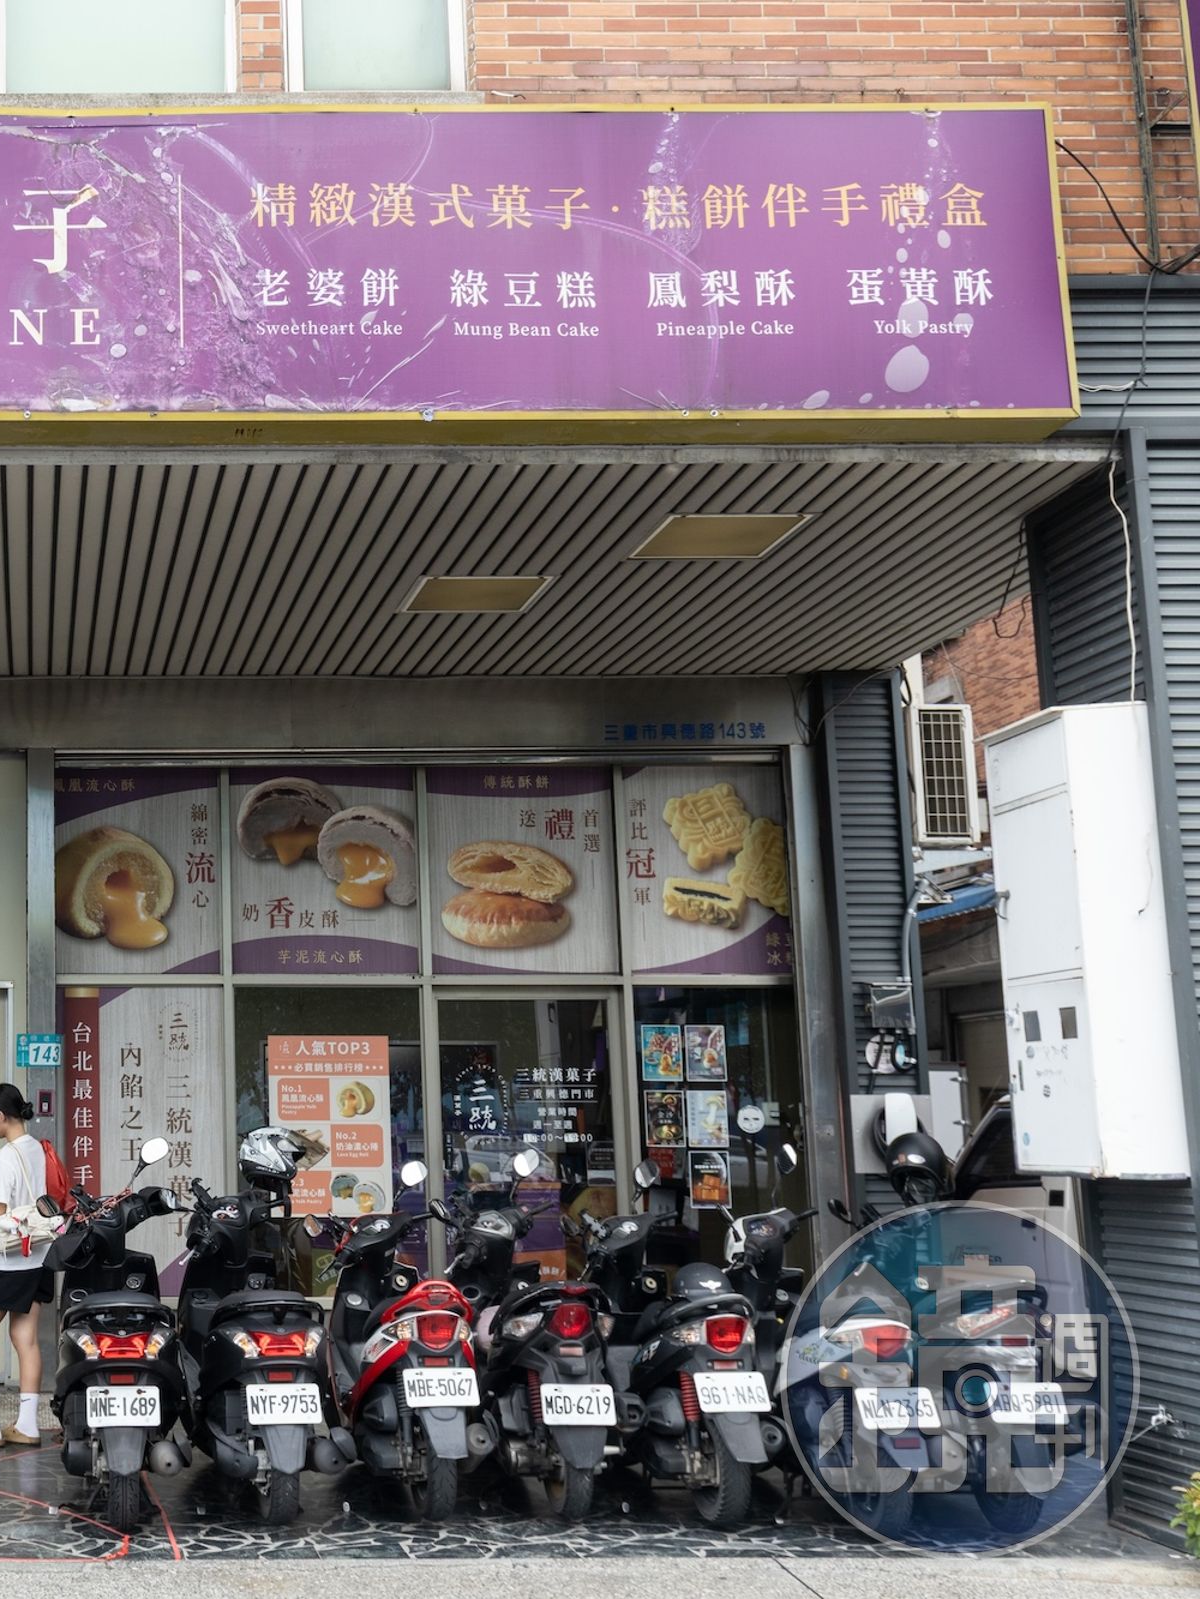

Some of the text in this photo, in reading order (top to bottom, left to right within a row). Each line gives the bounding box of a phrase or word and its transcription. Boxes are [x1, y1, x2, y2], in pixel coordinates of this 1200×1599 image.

[252, 267, 995, 309] 老婆餅 綠豆糕 鳳梨酥 蛋黃酥
[255, 321, 404, 337] Sweetheart Cake
[453, 322, 600, 340] Mung Bean Cake
[656, 321, 795, 340] Pineapple Cake
[873, 319, 974, 338] Yolk Pastry
[482, 775, 550, 790] 傳統酥餅
[625, 798, 657, 907] 評比冠軍
[241, 896, 340, 931] 奶香皮酥
[277, 949, 364, 965] 芋泥流心酥
[32, 1045, 61, 1063] 143
[295, 1040, 371, 1056] 人氣TOP3
[516, 1067, 597, 1082] 三統漢菓子
[281, 1084, 303, 1093] No.1
[71, 1021, 94, 1199] 台北最佳伴手
[335, 1131, 357, 1140] No.2
